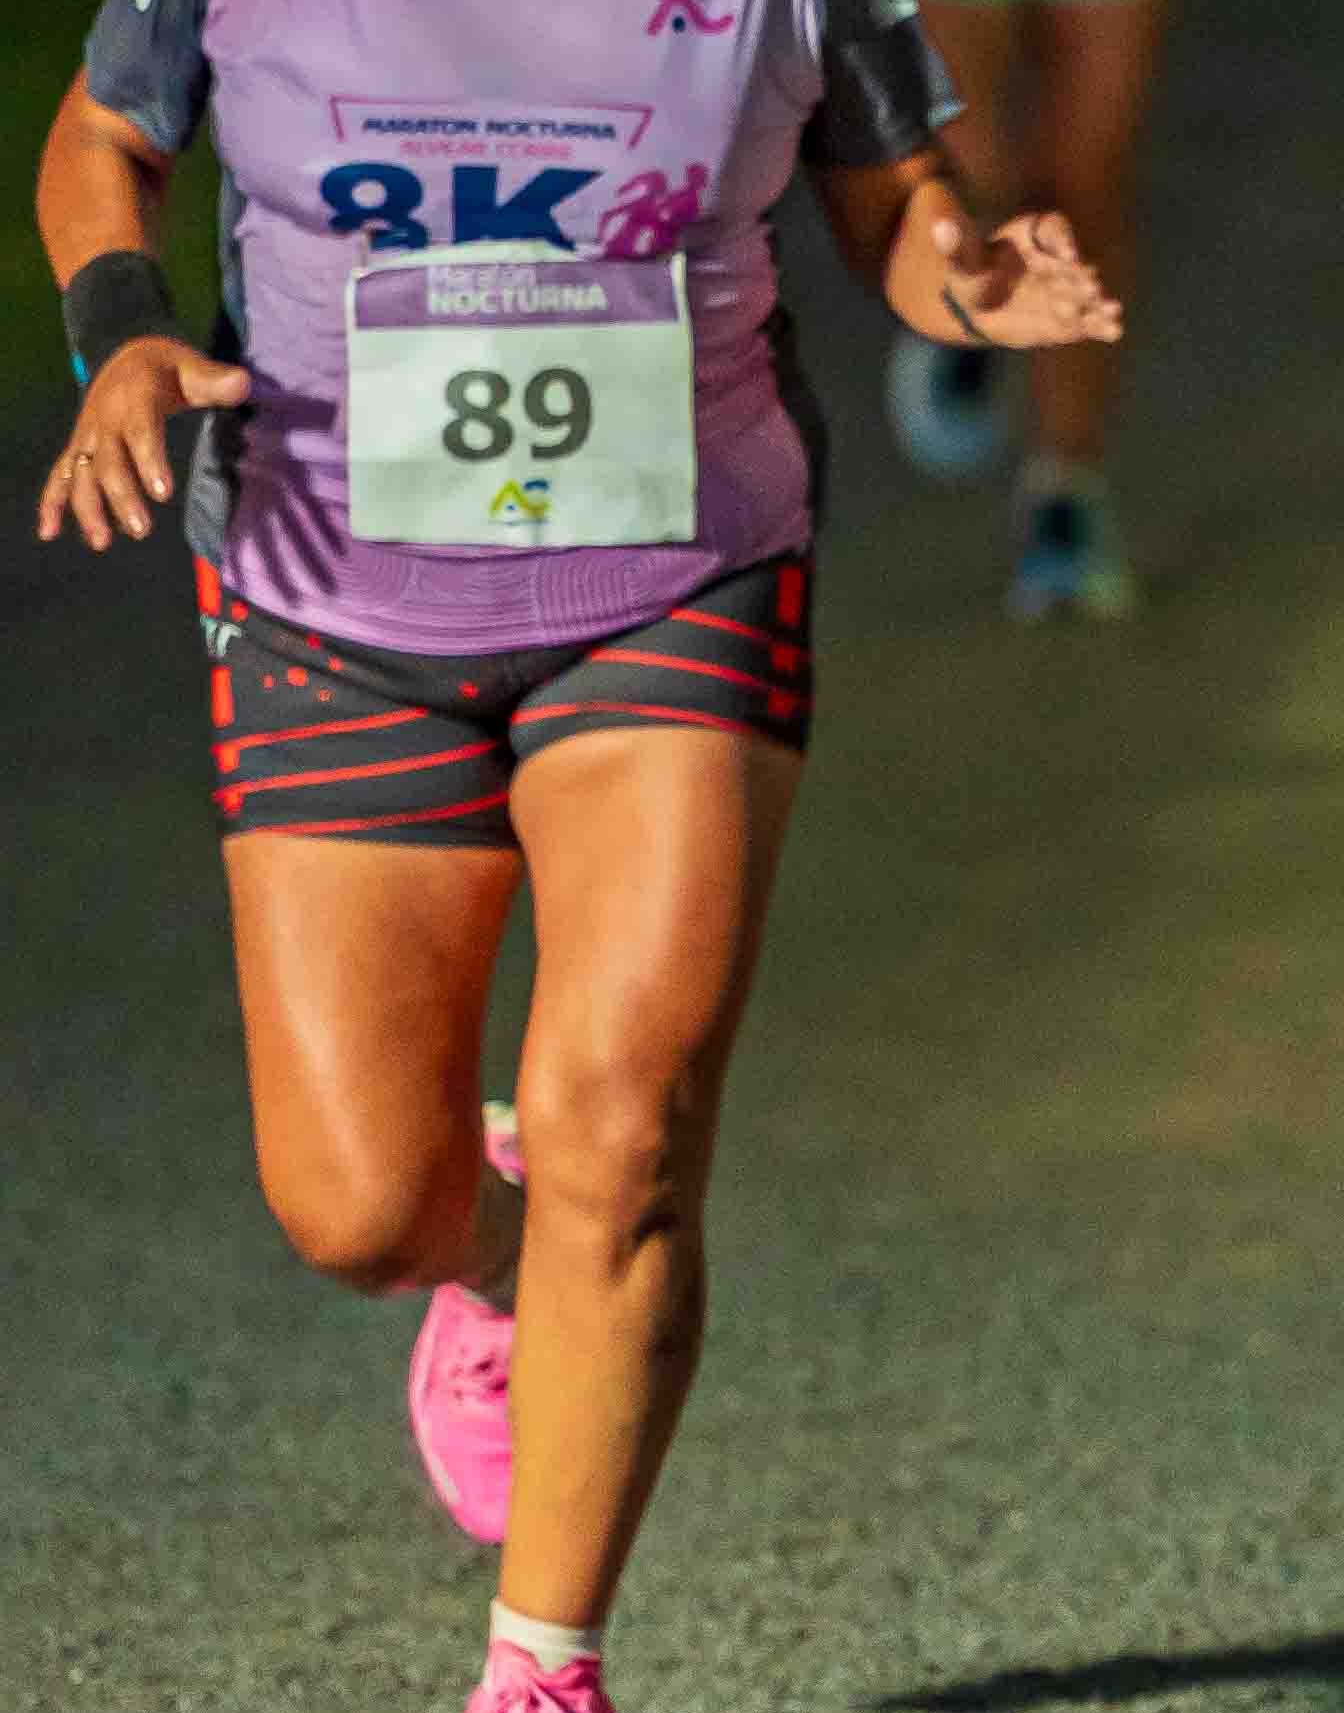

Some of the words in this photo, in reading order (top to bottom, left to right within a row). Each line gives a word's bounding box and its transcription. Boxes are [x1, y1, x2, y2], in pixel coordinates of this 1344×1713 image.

[485, 118, 617, 140] NOCTURNA
[320, 161, 604, 252] 8K
[427, 286, 609, 316] NOCTURNA
[442, 367, 592, 463] 89
